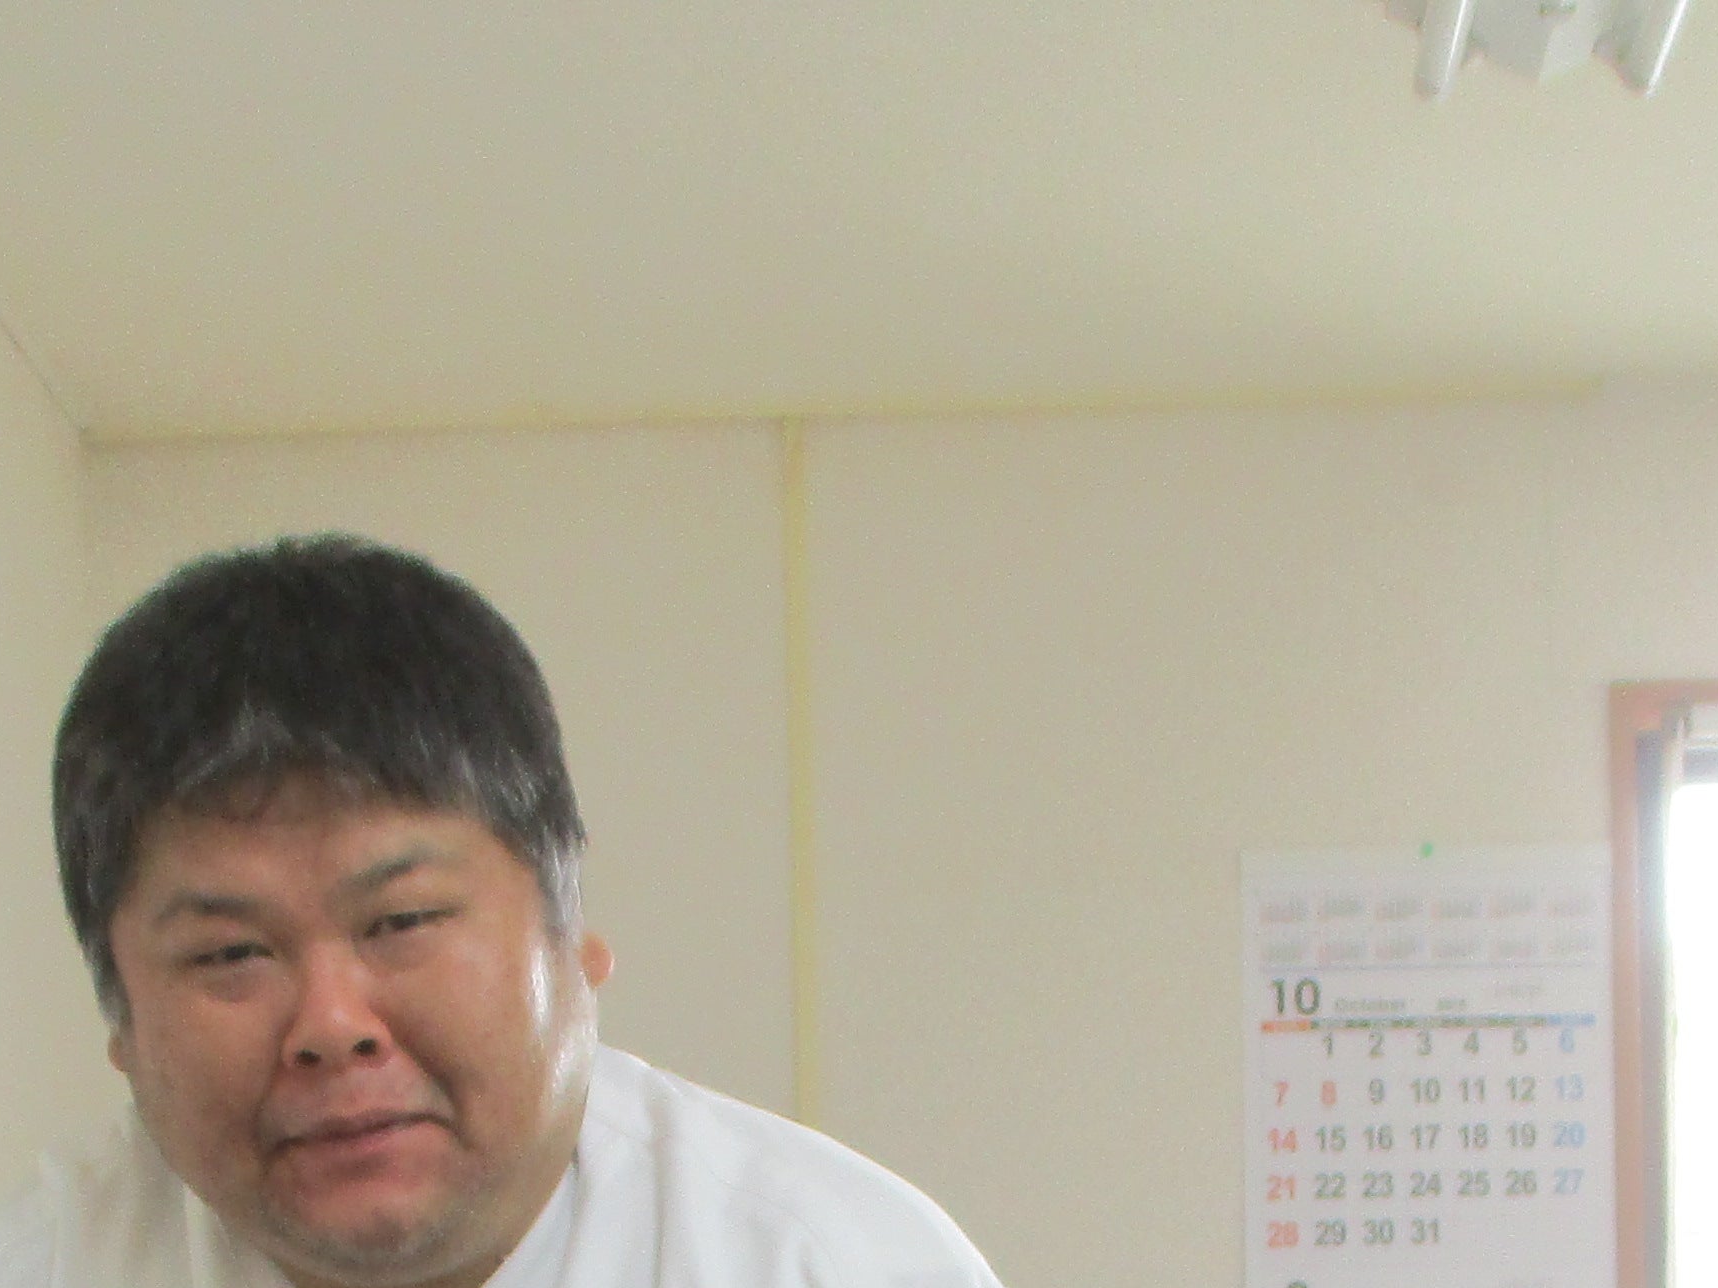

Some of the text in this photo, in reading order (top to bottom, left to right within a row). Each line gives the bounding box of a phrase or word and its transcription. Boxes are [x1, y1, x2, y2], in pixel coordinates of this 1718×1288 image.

[1271, 978, 1321, 1015] 10
[1321, 1029, 1575, 1058] 1 2 3 4 5 6
[1274, 1082, 1289, 1107] 7
[1368, 1079, 1385, 1104] 9
[1410, 1077, 1441, 1103] 10
[1458, 1077, 1486, 1103] 11
[1506, 1076, 1536, 1102] 12
[1556, 1075, 1582, 1099] 13
[1269, 1122, 1583, 1153] 14 15 16 17 18 19 20
[1266, 1168, 1583, 1200] 21 22 23 24 25 26 27
[1267, 1218, 1440, 1249] 28 29 30 31
